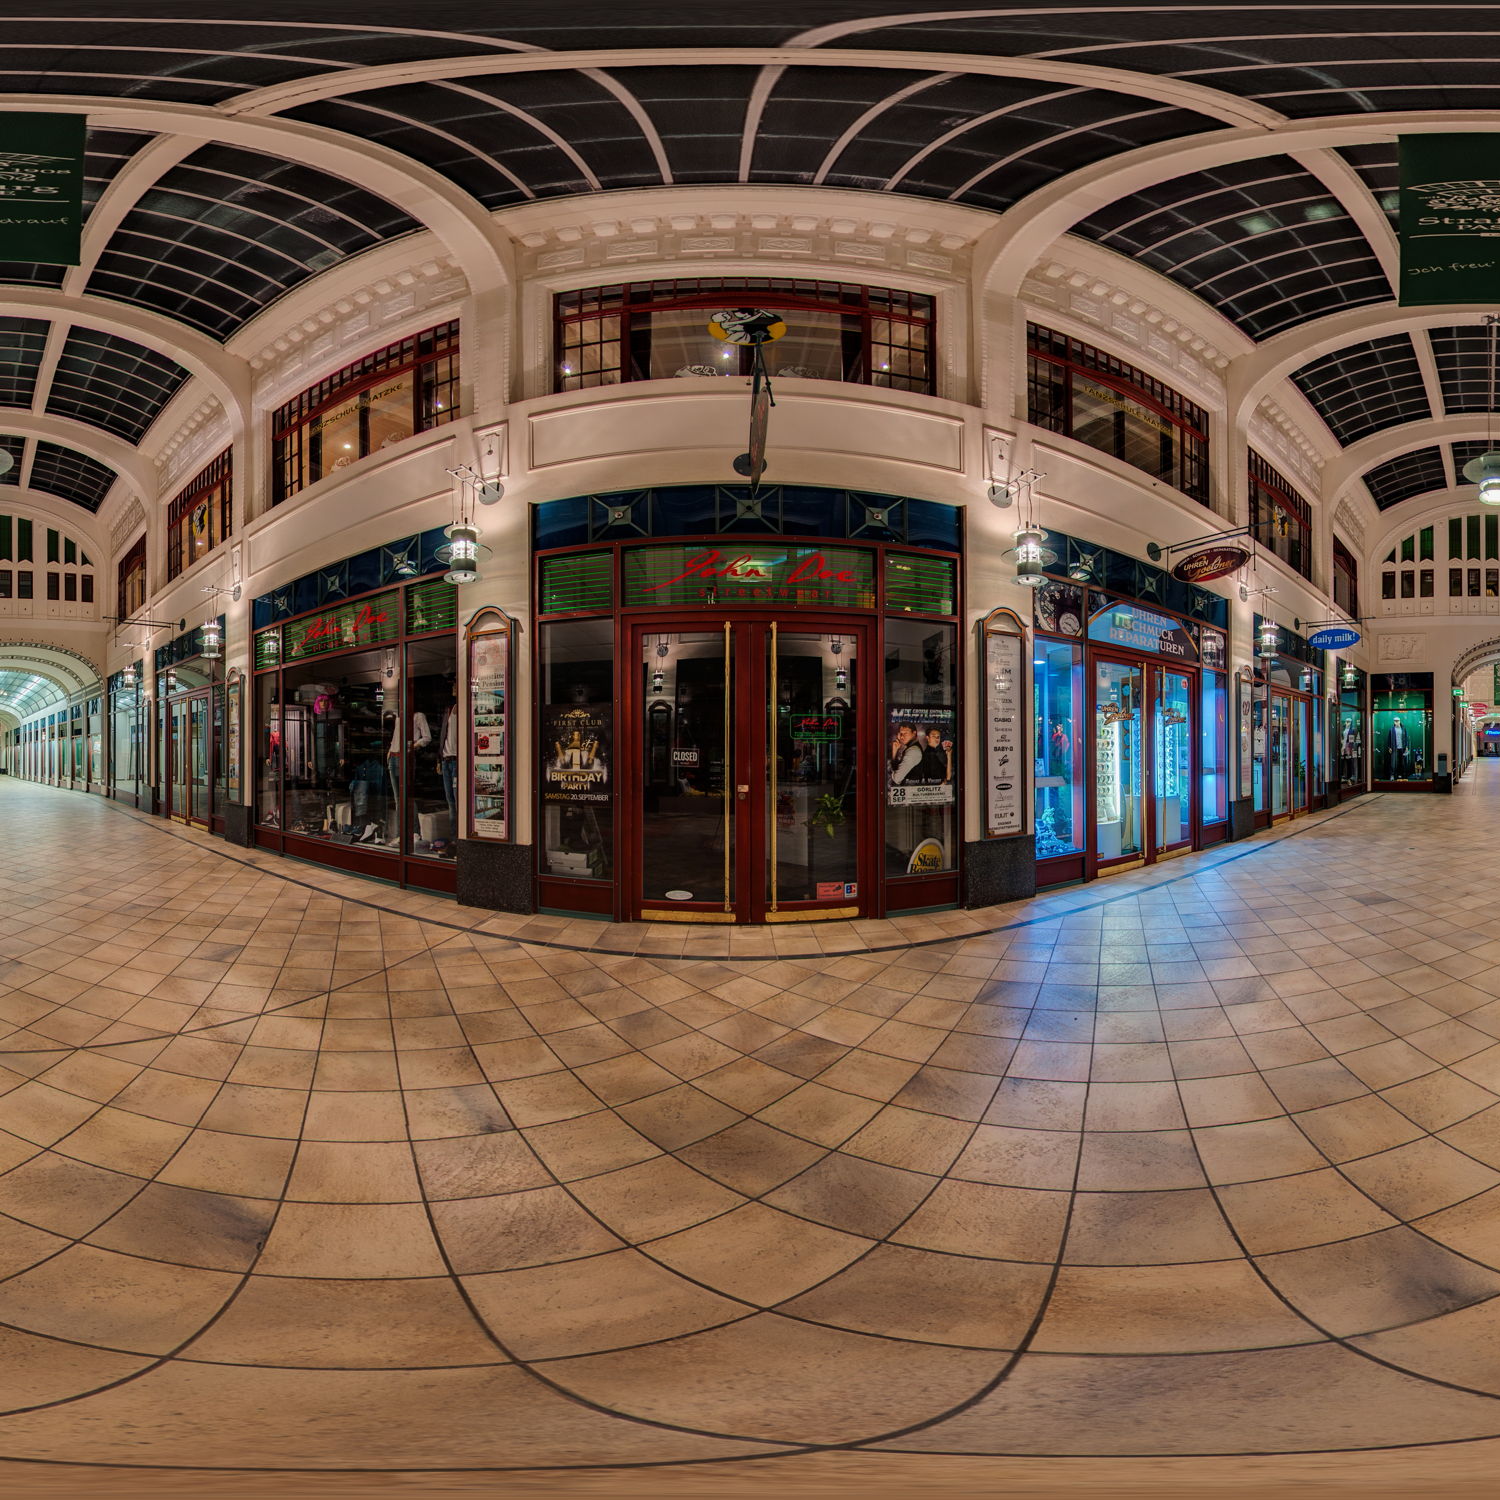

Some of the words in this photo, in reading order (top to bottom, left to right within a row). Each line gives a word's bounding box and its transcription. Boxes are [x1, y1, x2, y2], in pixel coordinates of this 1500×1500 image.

[643, 550, 766, 592] John
[786, 553, 858, 584] Doe
[1183, 560, 1209, 571] UHREN
[1131, 607, 1167, 627] UHREN
[1109, 628, 1185, 656] REPARATUREN
[1312, 635, 1333, 645] daily
[1334, 632, 1356, 643] milk!
[553, 719, 577, 727] FIRST
[580, 719, 603, 727] CLUB
[673, 751, 698, 762] CLOSED
[551, 772, 602, 782] BIRTHDAY
[563, 781, 588, 791] PARTY
[544, 792, 570, 800] SAMSTAG
[892, 788, 906, 797] 28
